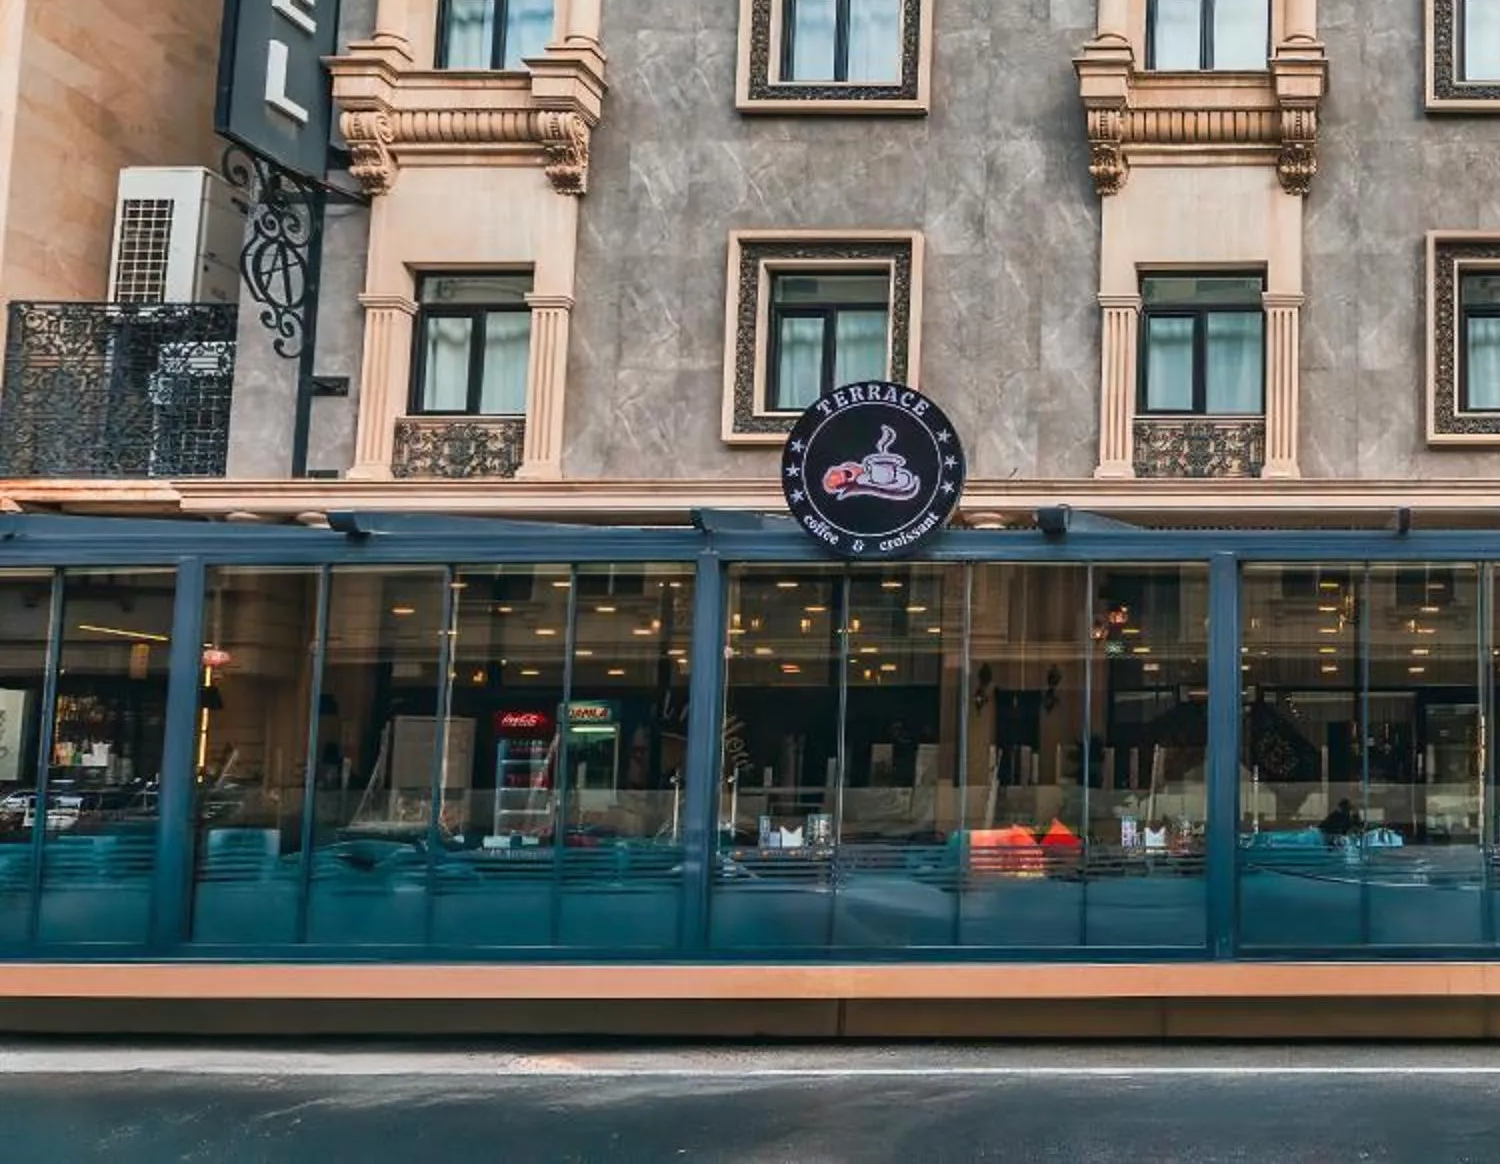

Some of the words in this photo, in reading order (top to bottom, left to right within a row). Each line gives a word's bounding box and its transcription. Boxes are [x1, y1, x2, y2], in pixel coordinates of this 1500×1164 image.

[816, 385, 930, 416] TERRACE
[802, 514, 840, 546] coffee
[852, 539, 865, 553] &
[878, 511, 940, 552] croissant
